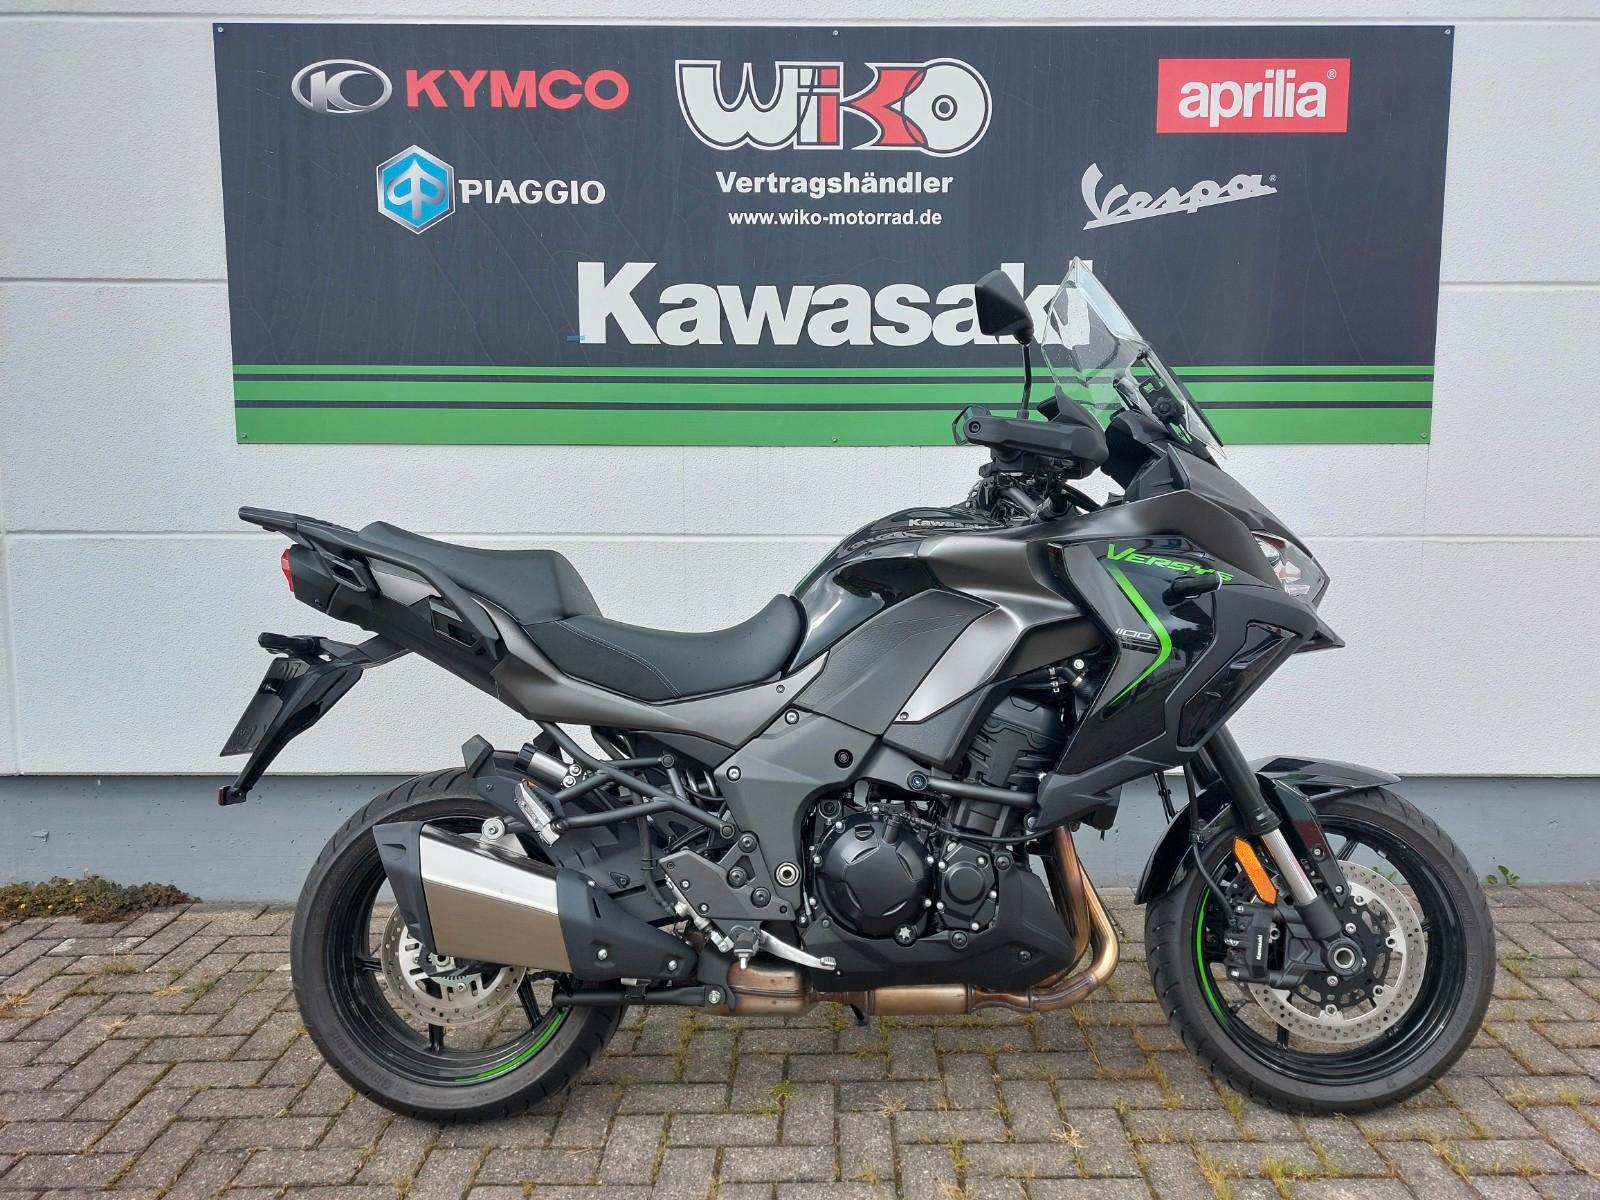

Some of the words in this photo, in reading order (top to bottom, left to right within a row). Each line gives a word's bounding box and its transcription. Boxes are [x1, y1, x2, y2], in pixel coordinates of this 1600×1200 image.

[406, 69, 629, 109] KYMCO
[458, 179, 606, 204] PIAGGIO
[715, 172, 954, 199] Vertragshändler
[728, 209, 943, 225] www.wiko-motorrad.de
[1115, 628, 1153, 640] 1100
